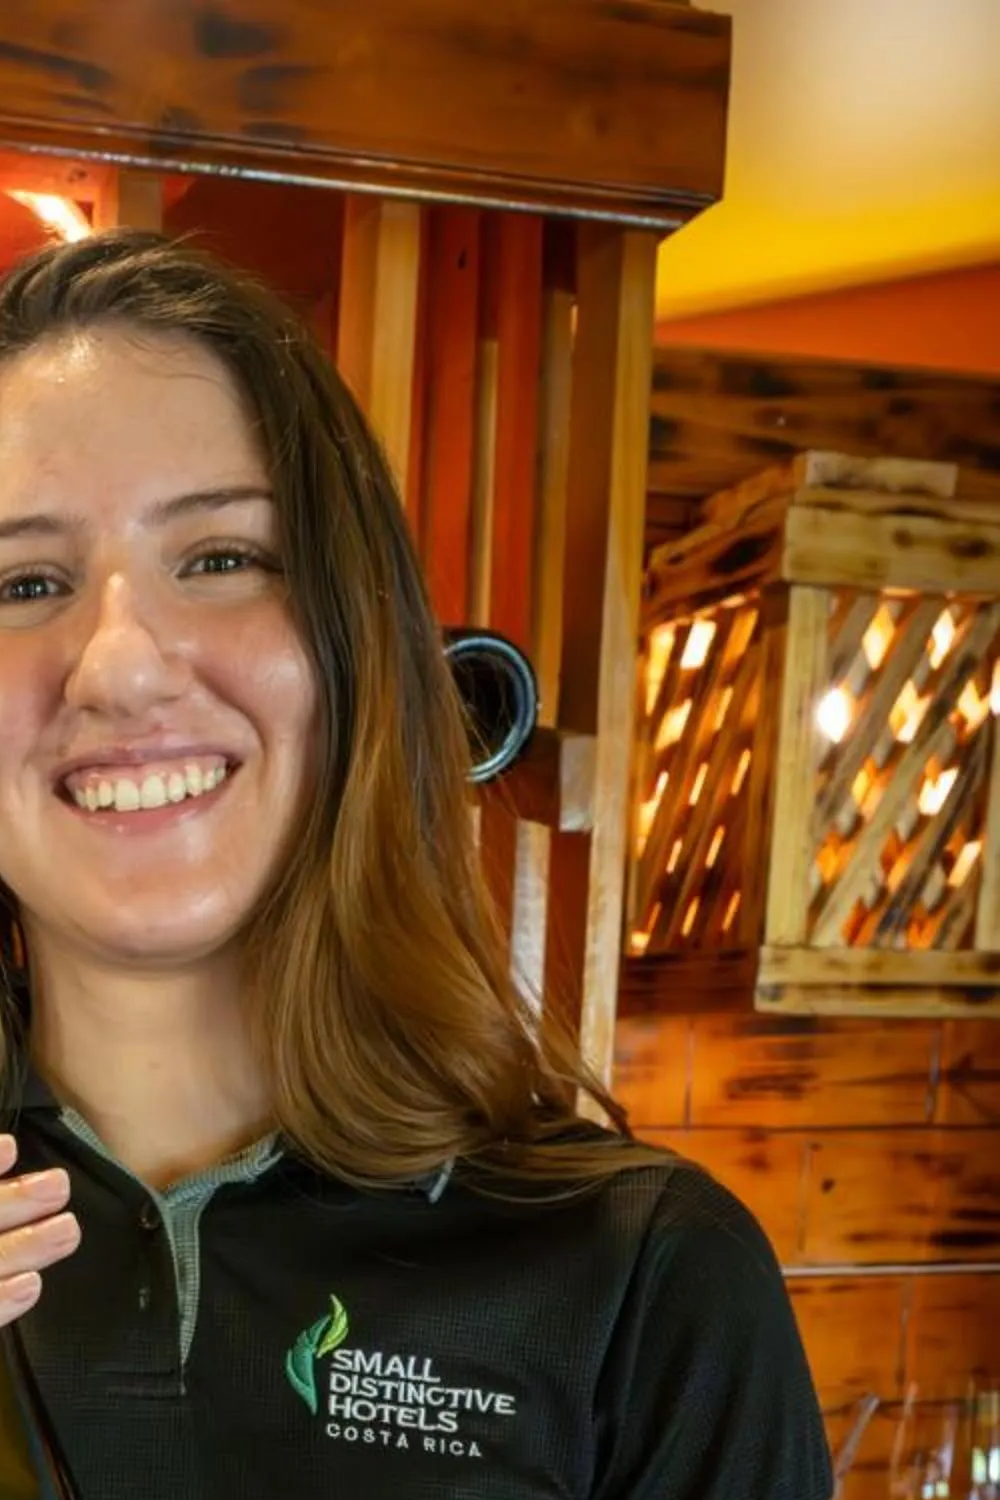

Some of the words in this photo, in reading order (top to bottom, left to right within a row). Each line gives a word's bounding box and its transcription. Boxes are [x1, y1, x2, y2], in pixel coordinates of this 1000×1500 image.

[331, 1349, 441, 1383] SMALL
[329, 1373, 517, 1415] DISTINCTIVE
[328, 1396, 459, 1433] HOTELS
[326, 1423, 409, 1449] COSTA
[423, 1437, 483, 1457] RICA
